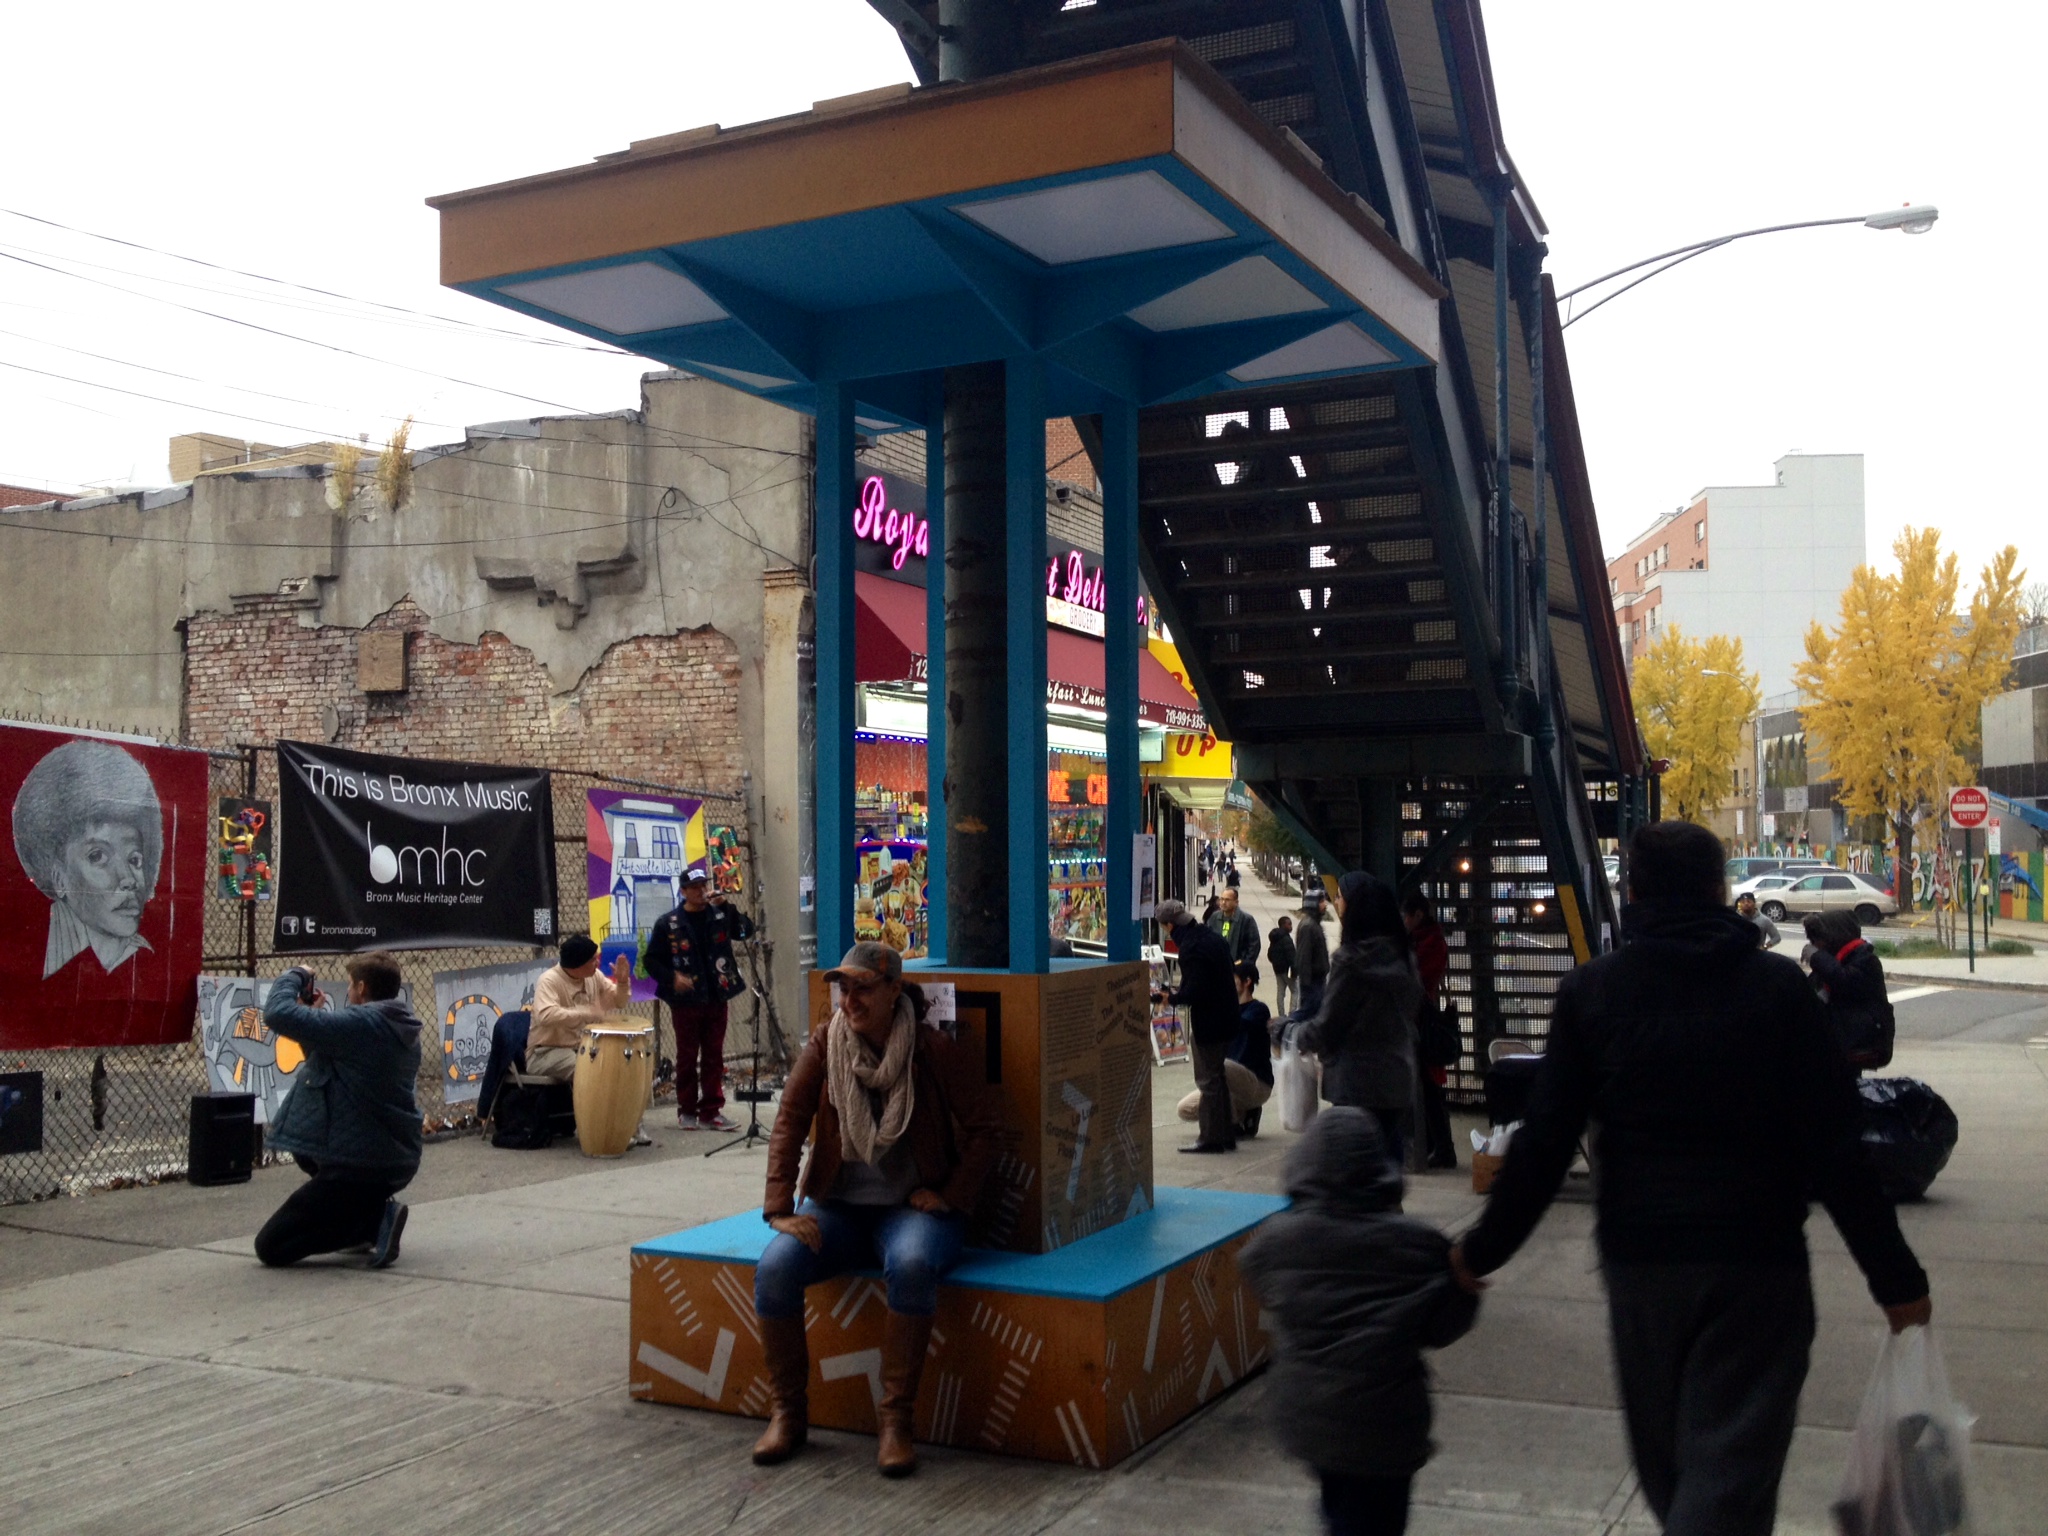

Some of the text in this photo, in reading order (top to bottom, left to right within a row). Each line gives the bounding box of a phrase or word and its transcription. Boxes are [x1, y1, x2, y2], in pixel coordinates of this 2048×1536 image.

[854, 475, 927, 570] Roya
[1069, 605, 1097, 632] GROCERY
[915, 658, 927, 679] 12
[1046, 681, 1074, 704] kfast
[1080, 686, 1106, 708] Lunc
[302, 763, 532, 812] This is Bronx Music.
[1955, 795, 1981, 803] DO NOT
[1958, 812, 1981, 821] ENTER
[367, 820, 487, 886] bmhc
[366, 890, 484, 906] Bronx Music Heritage Center
[321, 925, 377, 937] bronxmusic.org
